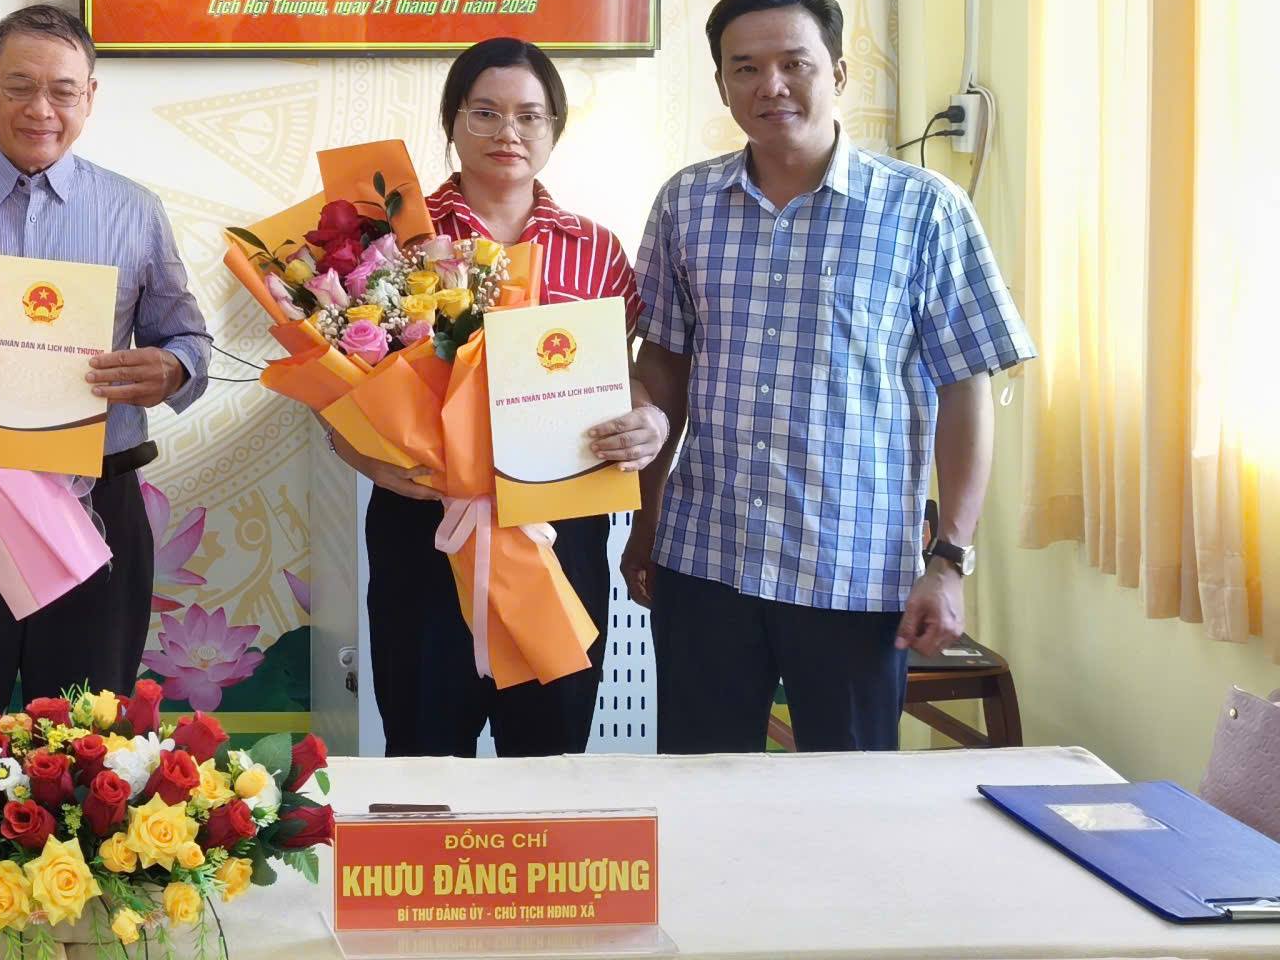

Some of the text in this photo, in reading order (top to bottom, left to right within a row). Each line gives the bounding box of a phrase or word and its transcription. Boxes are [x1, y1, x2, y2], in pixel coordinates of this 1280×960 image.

[506, 396, 521, 405] BAN
[445, 828, 548, 849] ĐỒNG CHÍ
[342, 857, 650, 899] KHƯU ĐĂNG PHƯỢNG
[398, 906, 409, 922] BÍ
[413, 906, 434, 921] THƯ
[436, 903, 466, 921] ĐẢNG
[470, 903, 484, 920] ỦY
[495, 902, 517, 920] CHỦ
[520, 905, 544, 922] TỊCH
[547, 904, 577, 919] HĐND
[580, 902, 595, 918] XÃ
